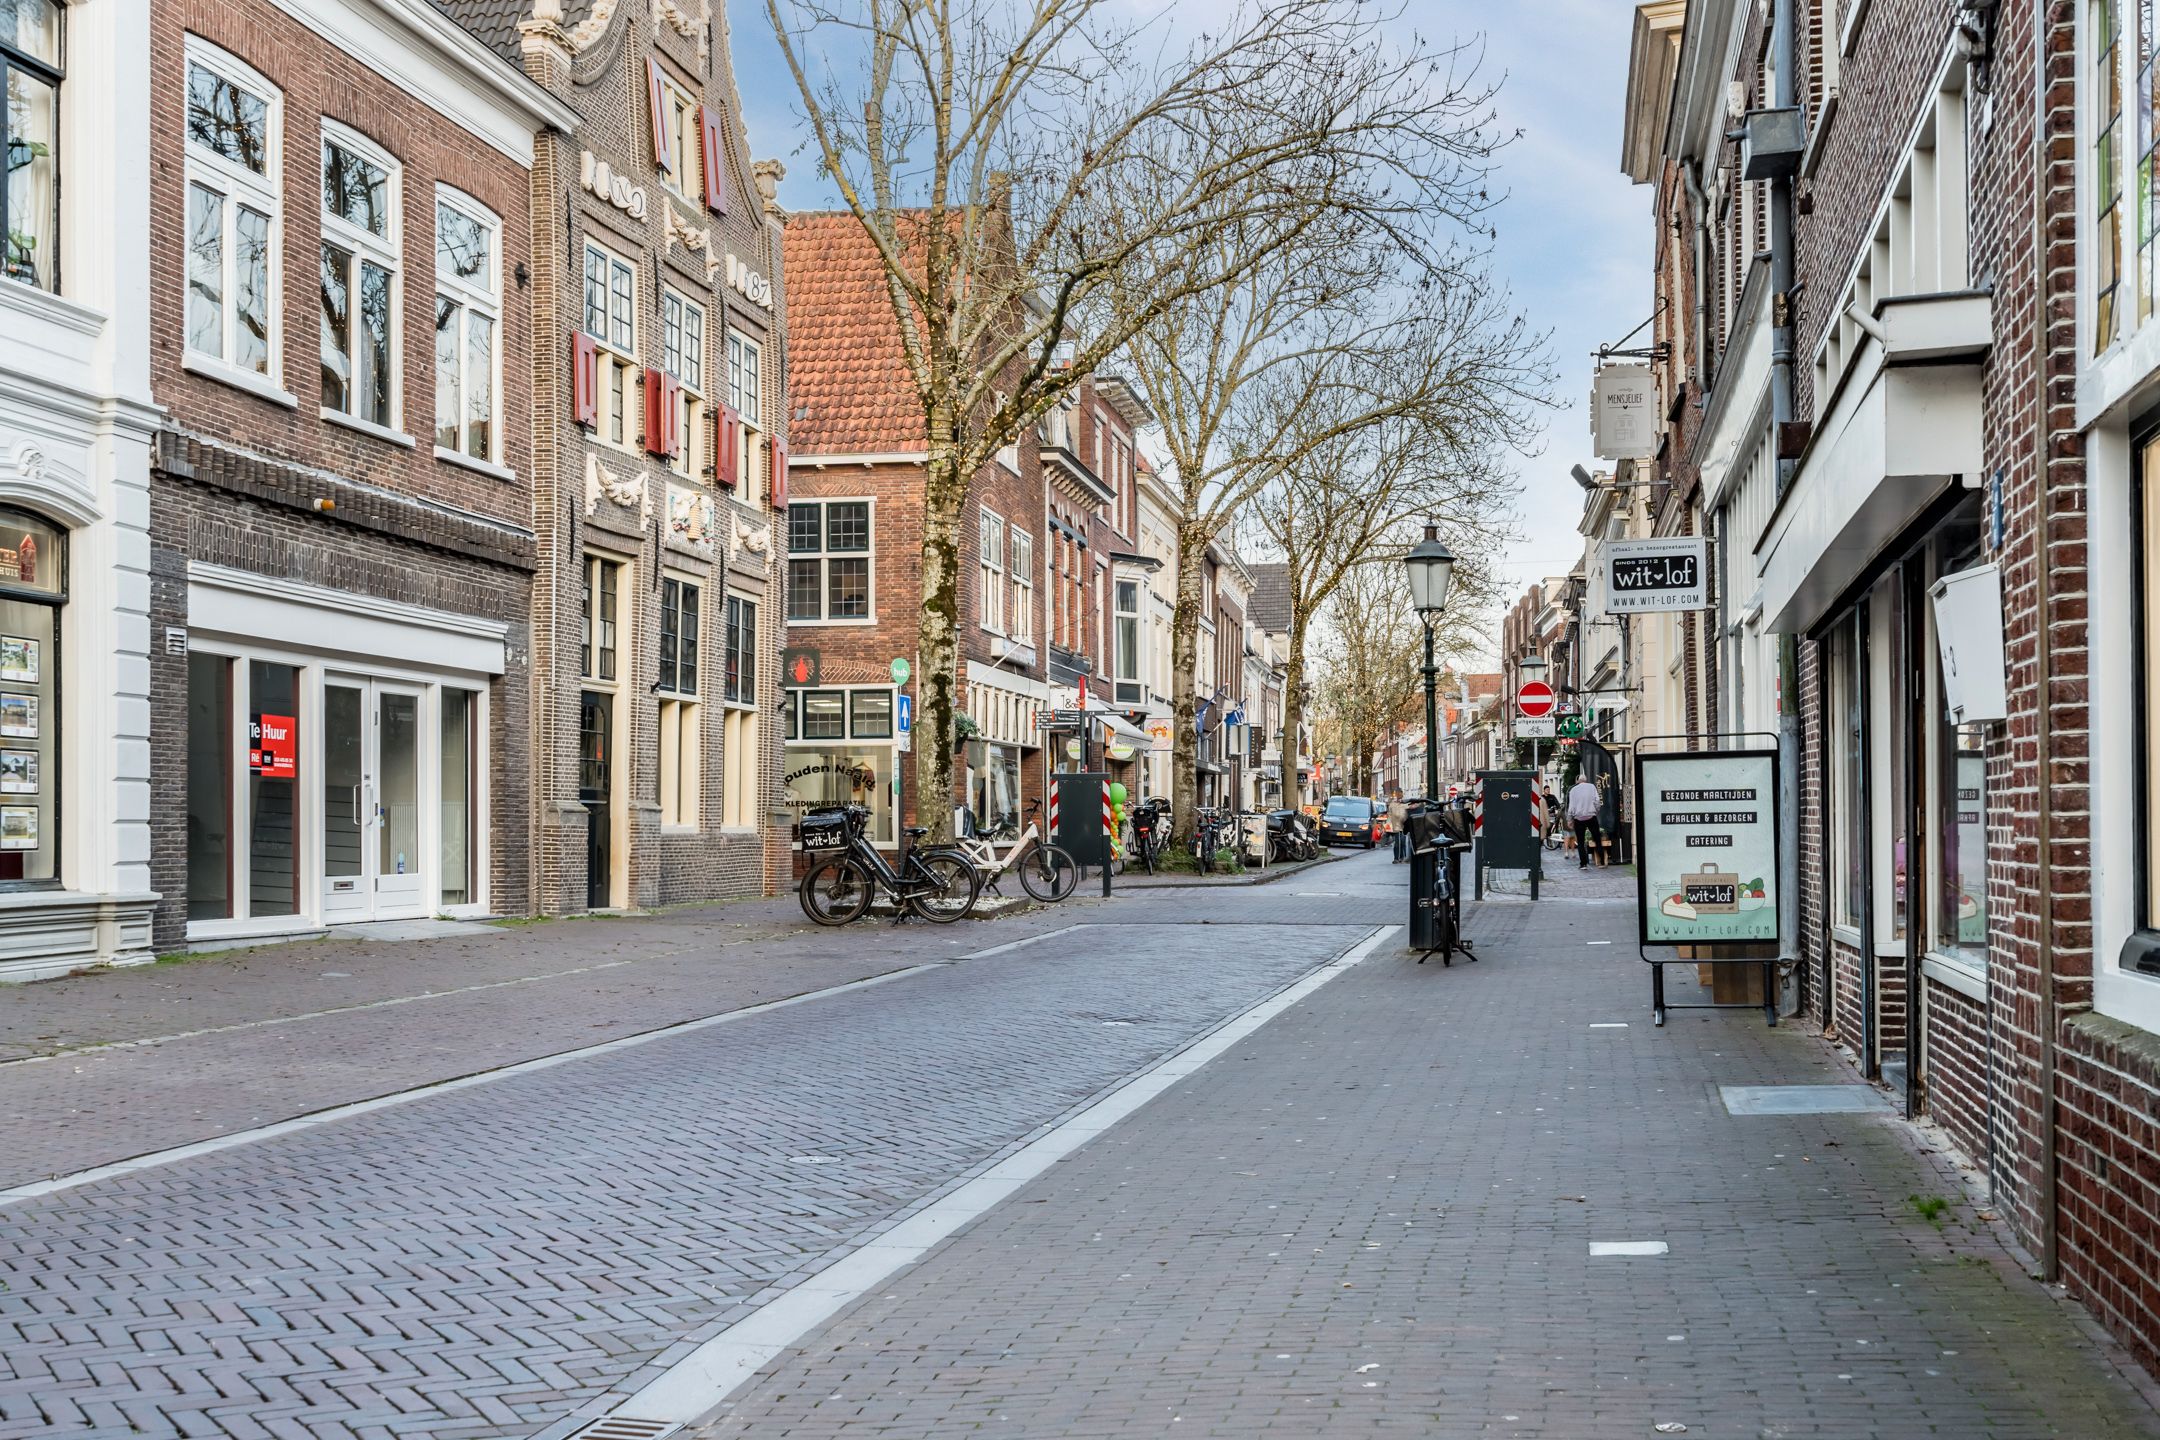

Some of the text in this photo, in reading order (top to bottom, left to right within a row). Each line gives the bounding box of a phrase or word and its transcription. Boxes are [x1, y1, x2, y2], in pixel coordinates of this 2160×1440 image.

[1607, 393, 1644, 404] MENSJELIEF
[1613, 594, 1699, 607] WWW.WIT-LOF.COM
[893, 668, 907, 677] hub
[1517, 718, 1554, 726] uitgezonderd
[249, 722, 287, 740] Te Huur
[784, 764, 876, 792] ouden Naald
[1666, 790, 1752, 800] GEZONDE MAALTIJDEN
[785, 800, 866, 808] KLEDINGREPARATIE
[1666, 813, 1753, 823] AFHALEN & BEZORGEN
[1690, 837, 1729, 846] CATERING
